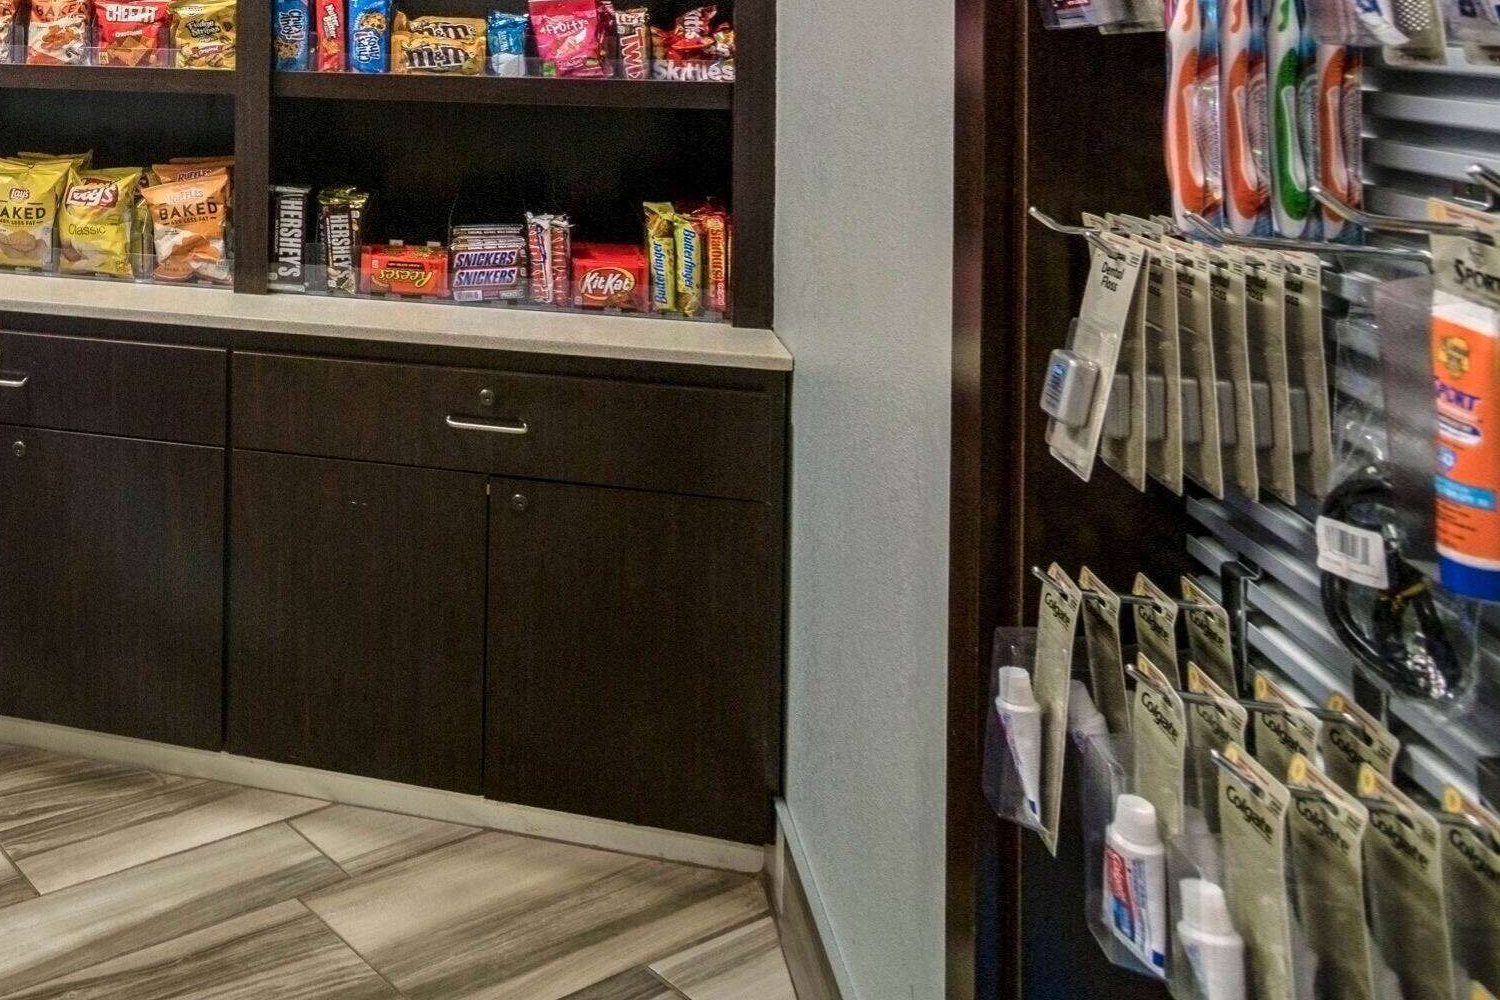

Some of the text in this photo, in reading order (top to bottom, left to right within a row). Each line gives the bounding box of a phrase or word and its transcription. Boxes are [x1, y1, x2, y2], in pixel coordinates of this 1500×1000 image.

[189, 19, 214, 31] Fudge
[653, 61, 735, 82] Skittles
[176, 170, 212, 182] RUFFLES
[158, 201, 218, 221] BAKED
[68, 223, 107, 236] Classic
[455, 250, 517, 268] SNICKERS
[681, 227, 697, 290] Butterfinger
[378, 267, 434, 288] Reese's
[455, 269, 517, 286] SNICKERS
[654, 240, 667, 305] Butterfinger
[1101, 261, 1125, 280] Dental
[1101, 274, 1119, 293] Floss
[1435, 378, 1482, 411] PORT
[1044, 592, 1072, 627] Colgate
[1140, 691, 1180, 738] Colgate
[1226, 784, 1274, 835] Colgate
